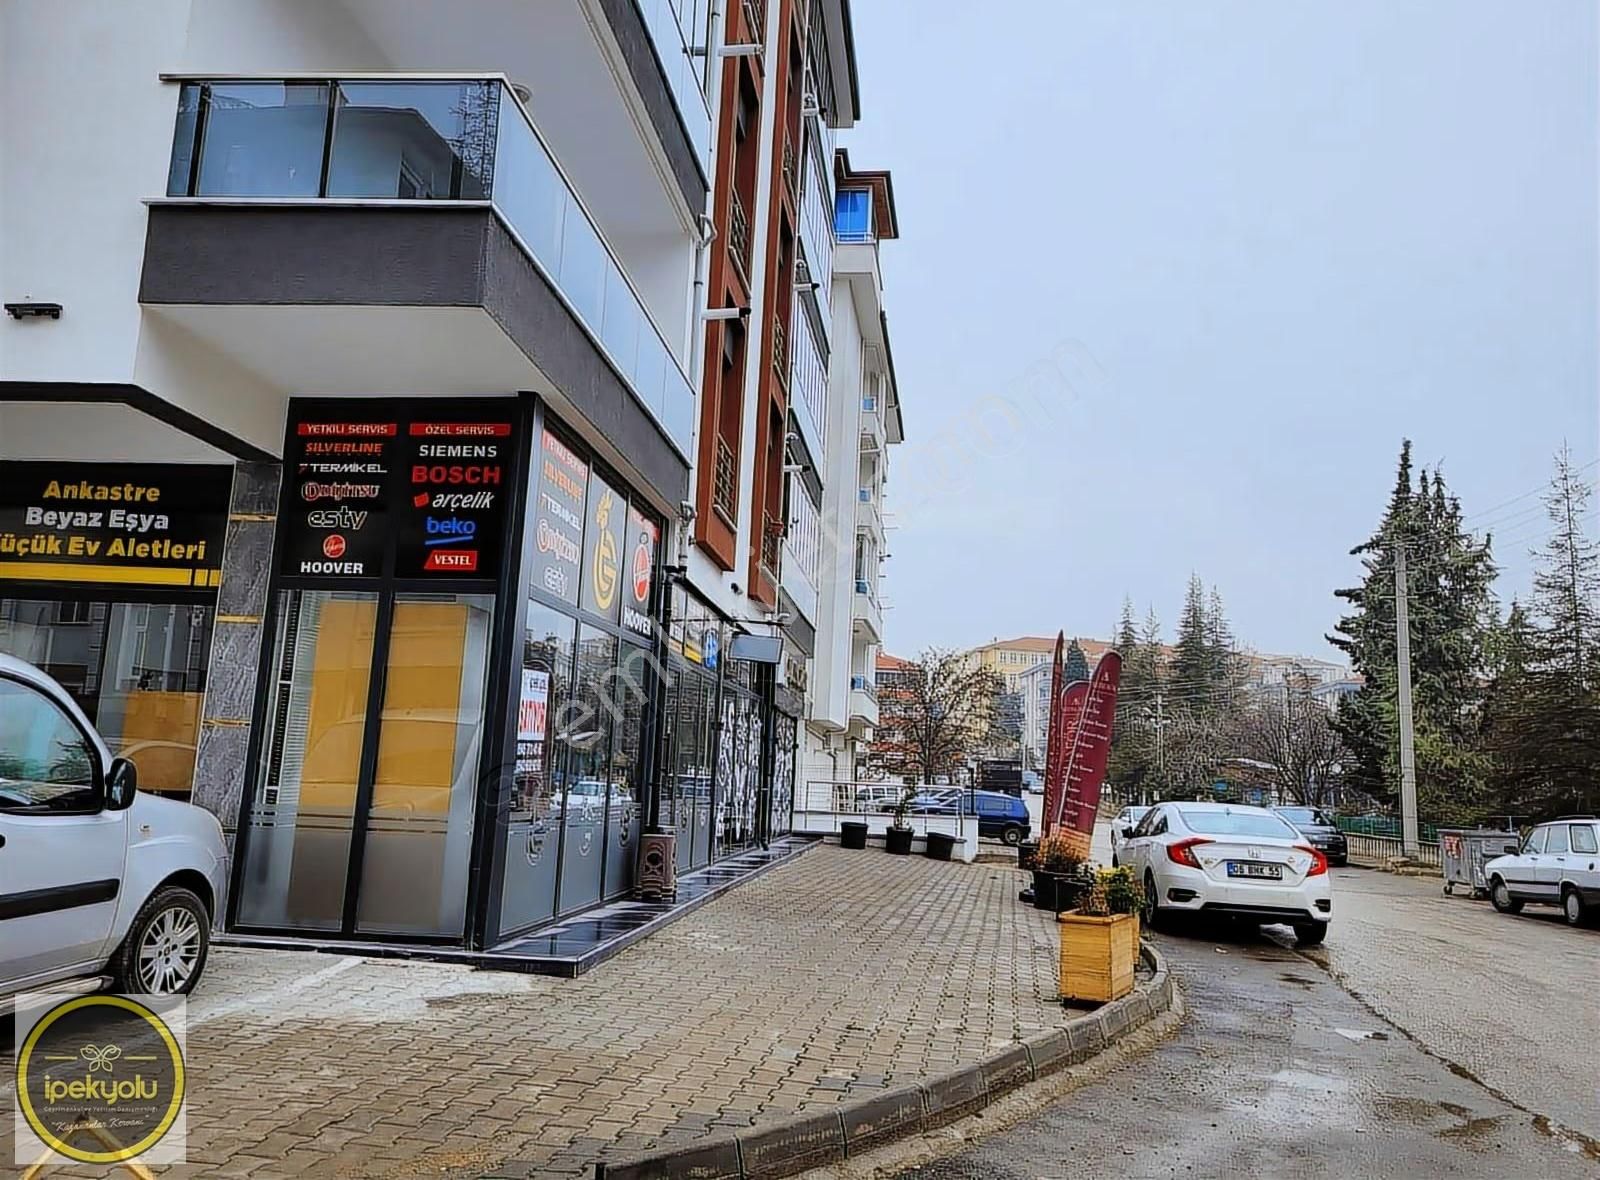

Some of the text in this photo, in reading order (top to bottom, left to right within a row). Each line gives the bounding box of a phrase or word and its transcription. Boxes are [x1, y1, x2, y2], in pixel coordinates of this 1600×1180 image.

[425, 424, 451, 435] ÖZEL
[419, 445, 497, 457] SIEMENS
[412, 465, 501, 484] BOSCH
[43, 480, 160, 501] Ankastre
[432, 491, 495, 512] arçelik
[25, 506, 169, 533] Beyaz Eşya
[426, 516, 475, 534] beko
[0, 533, 206, 560] üçük Ev Aletleri
[300, 561, 363, 574] HOOVER
[434, 554, 472, 565] VESTEL
